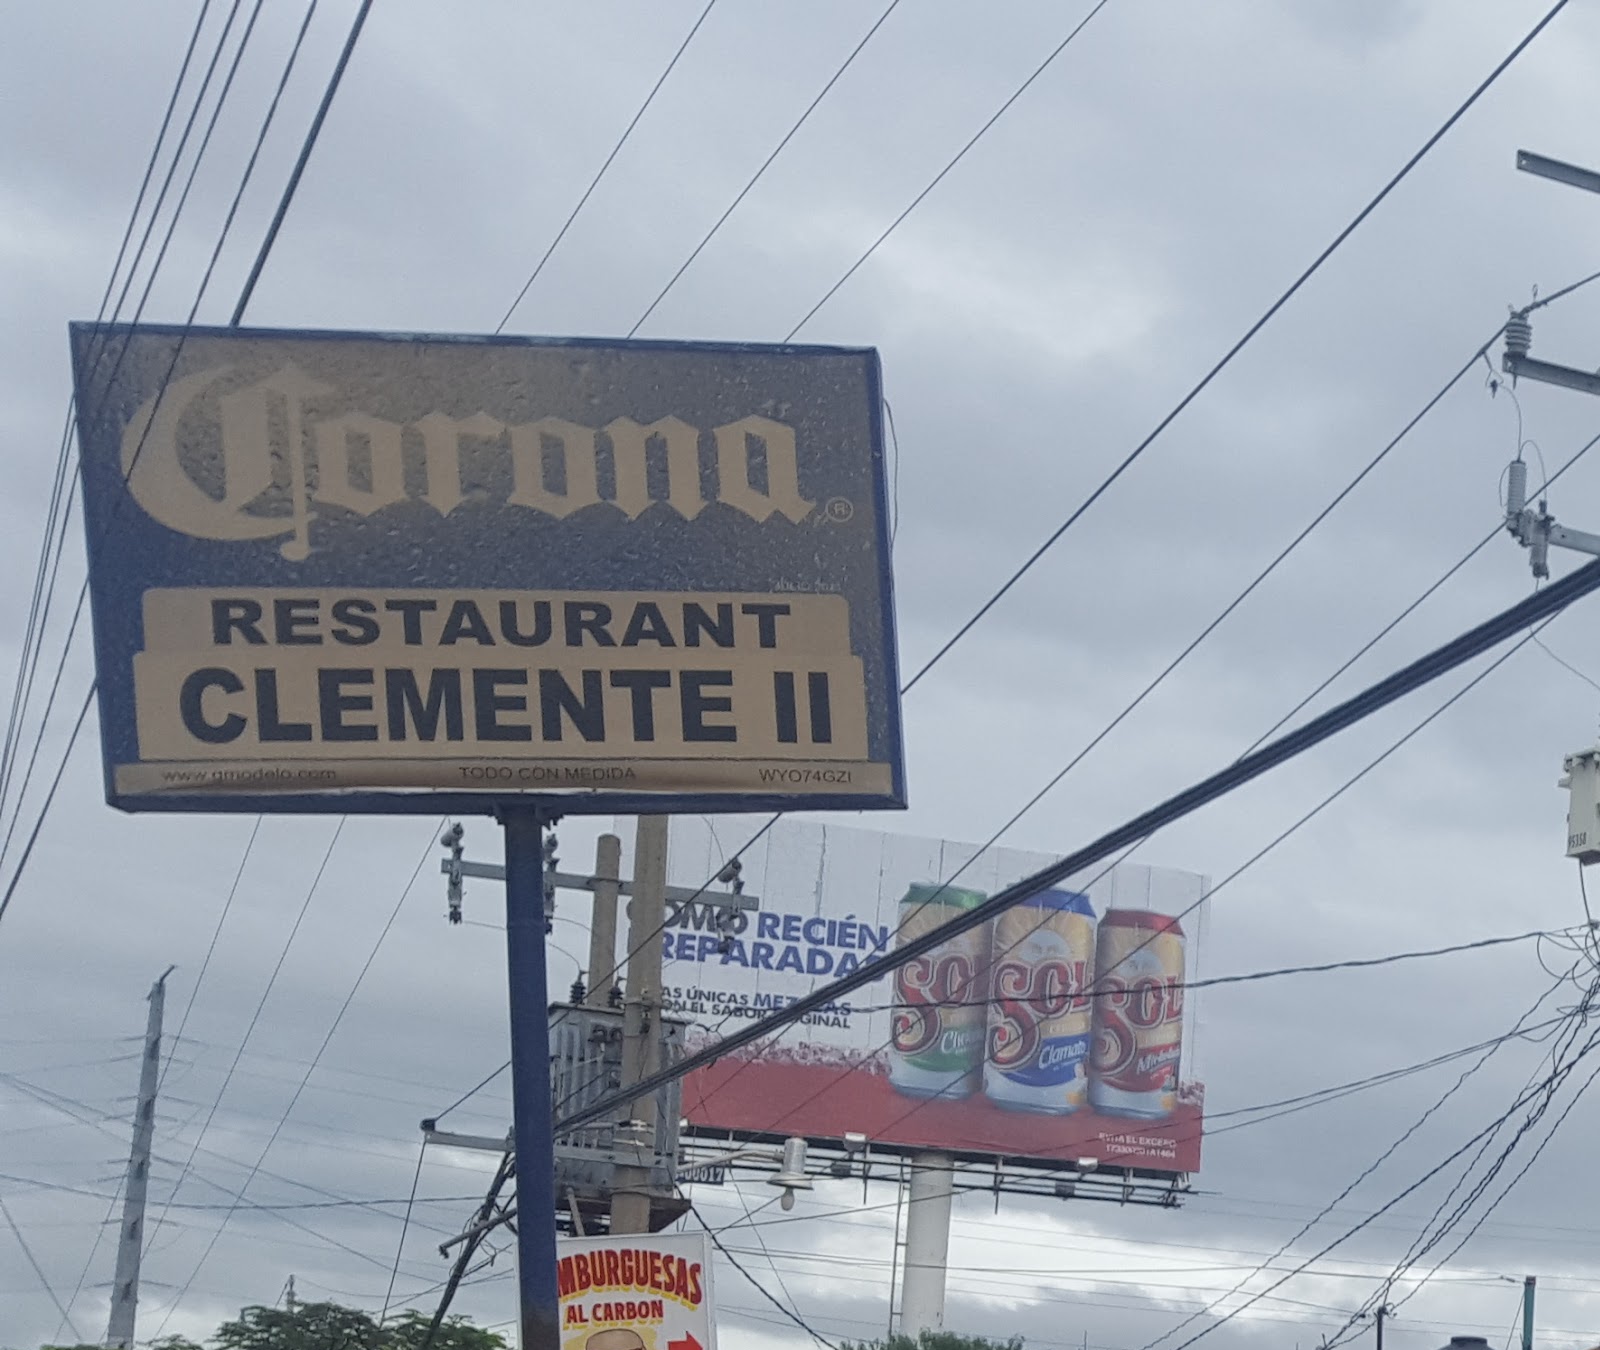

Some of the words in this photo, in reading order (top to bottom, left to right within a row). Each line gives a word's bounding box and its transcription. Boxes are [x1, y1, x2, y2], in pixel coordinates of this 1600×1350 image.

[120, 360, 817, 561] Corona
[212, 598, 792, 650] RESTAURANT
[180, 667, 738, 744] CLEMENTE
[774, 670, 832, 744] II
[459, 766, 512, 781] TODO
[518, 766, 560, 781] CON
[564, 766, 637, 782] MEDIDA
[629, 928, 886, 981] REPARADA
[758, 912, 888, 951] RECIÉN
[687, 985, 749, 1006] ÚNICAS
[557, 1249, 702, 1304] MBURGUESAS
[566, 1304, 589, 1324] AL
[592, 1300, 663, 1321] CARBON
